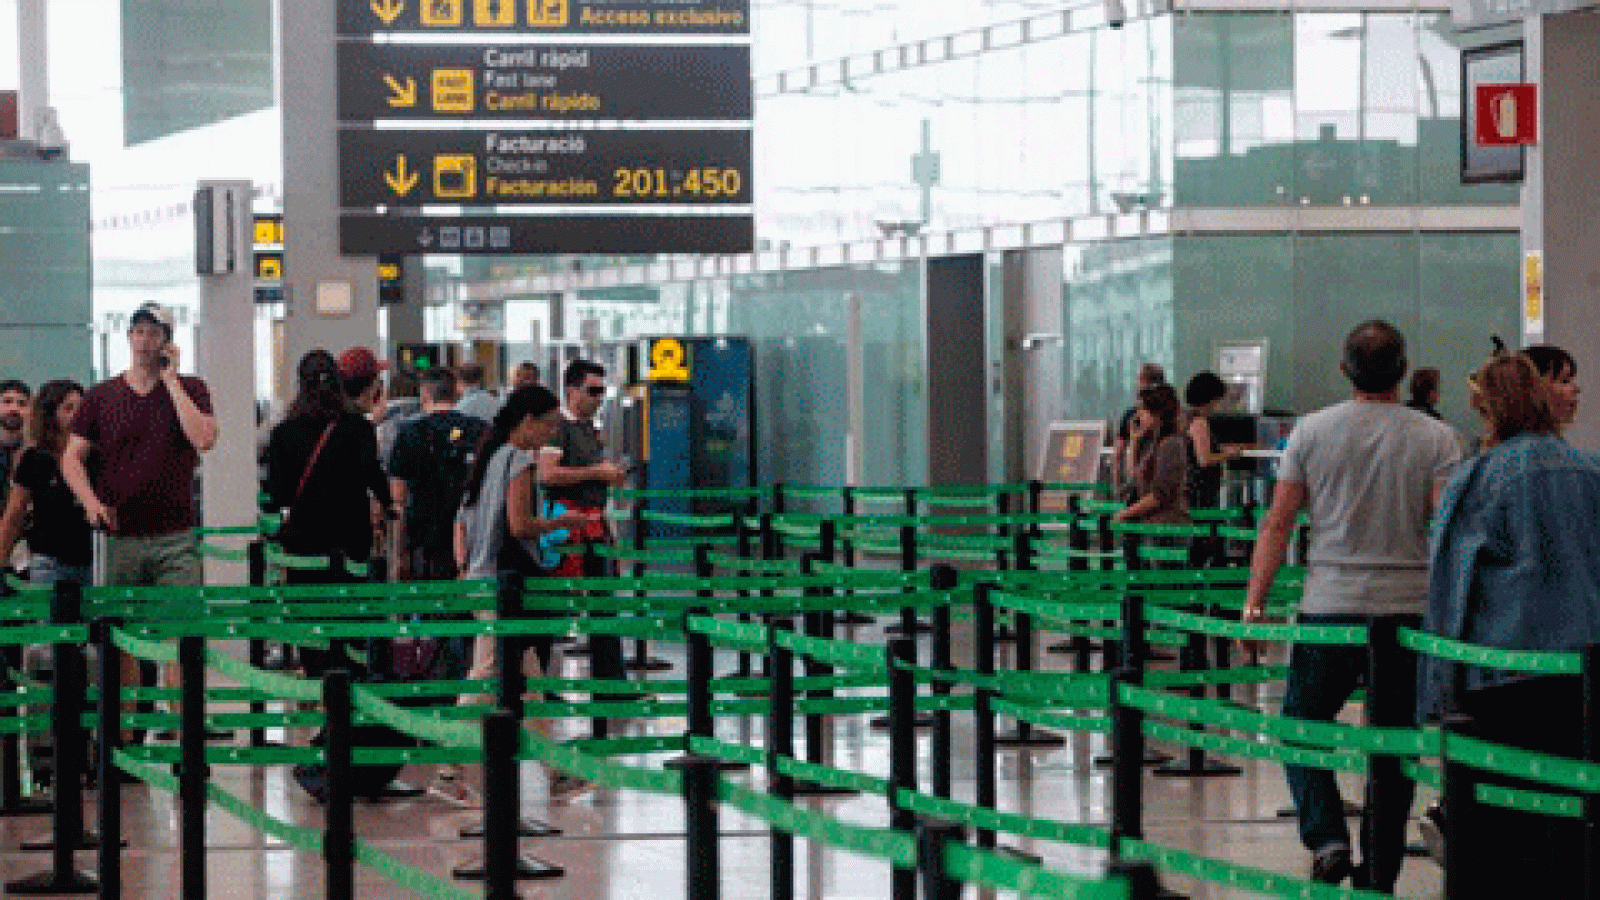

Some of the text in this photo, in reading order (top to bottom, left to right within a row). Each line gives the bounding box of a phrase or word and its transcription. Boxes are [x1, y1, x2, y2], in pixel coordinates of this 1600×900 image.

[580, 7, 744, 26] Acceso exclusivo
[484, 49, 535, 68] Carril
[484, 72, 557, 88] Fast lane
[484, 92, 536, 110] Carril
